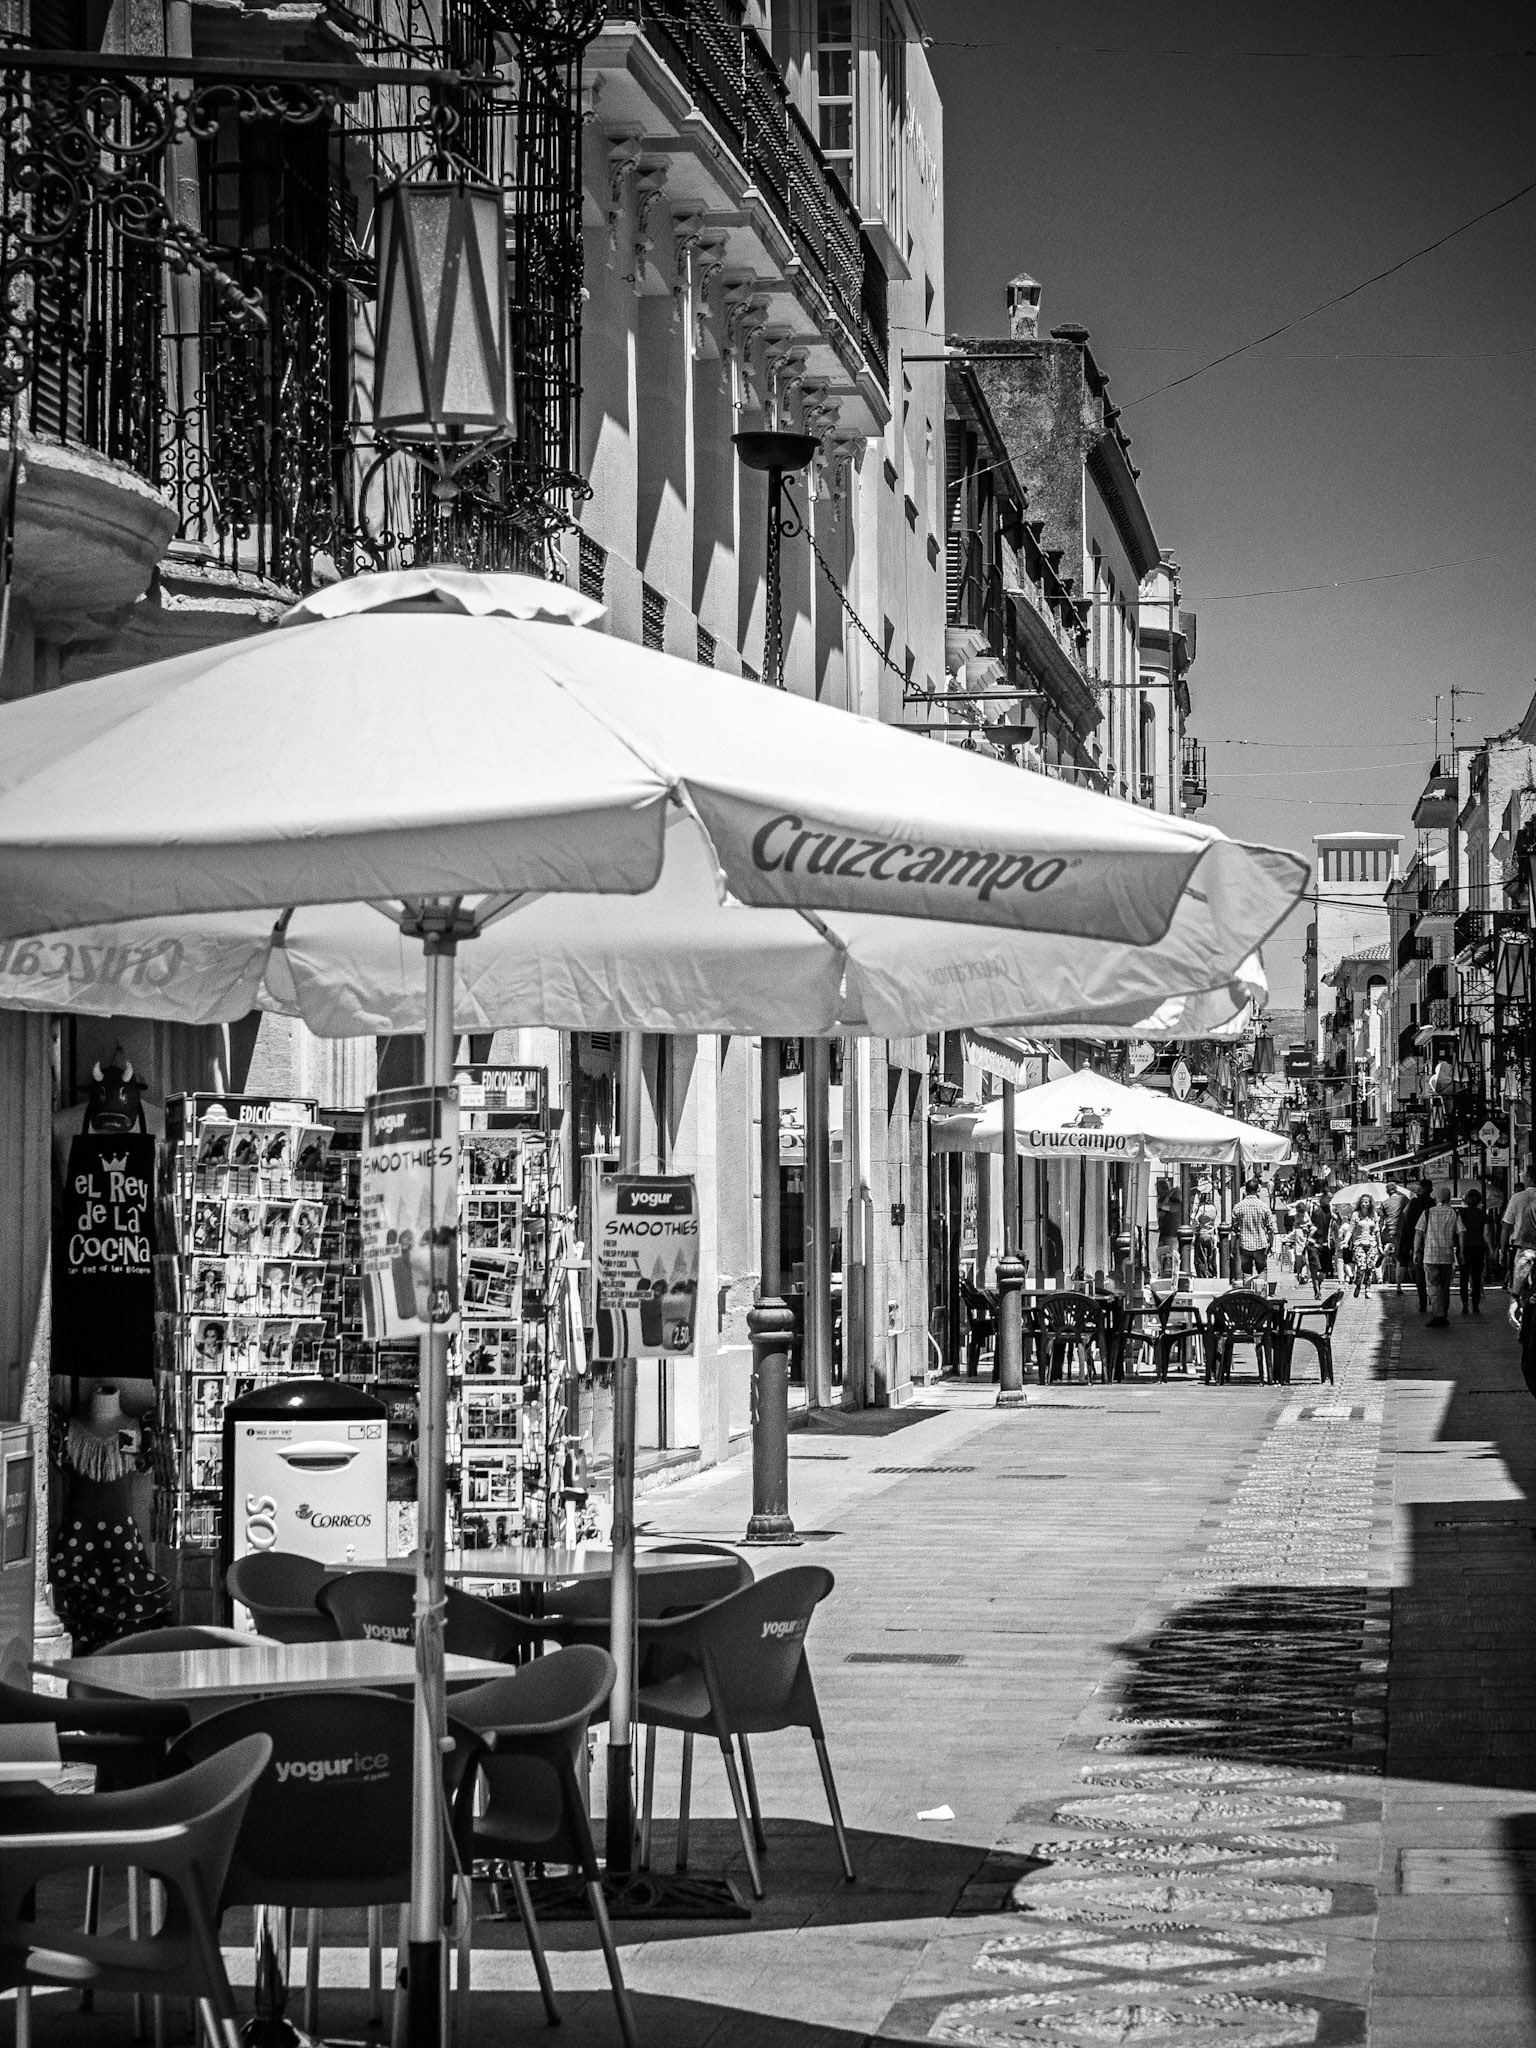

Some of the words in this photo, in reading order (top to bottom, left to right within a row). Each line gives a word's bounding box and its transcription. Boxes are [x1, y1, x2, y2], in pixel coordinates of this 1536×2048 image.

[752, 814, 1067, 901] Cruzcampo
[482, 1071, 522, 1091] EDICIONES
[524, 1071, 537, 1091] AM
[1029, 1129, 1126, 1151] Cruzcampo
[364, 1147, 453, 1175] SMOOTHIES
[110, 1172, 148, 1212] Rey
[78, 1201, 107, 1231] de
[605, 1220, 698, 1236] SMOOTHIES
[311, 1513, 371, 1528] CORREOS
[276, 1752, 389, 1782] yogurice
